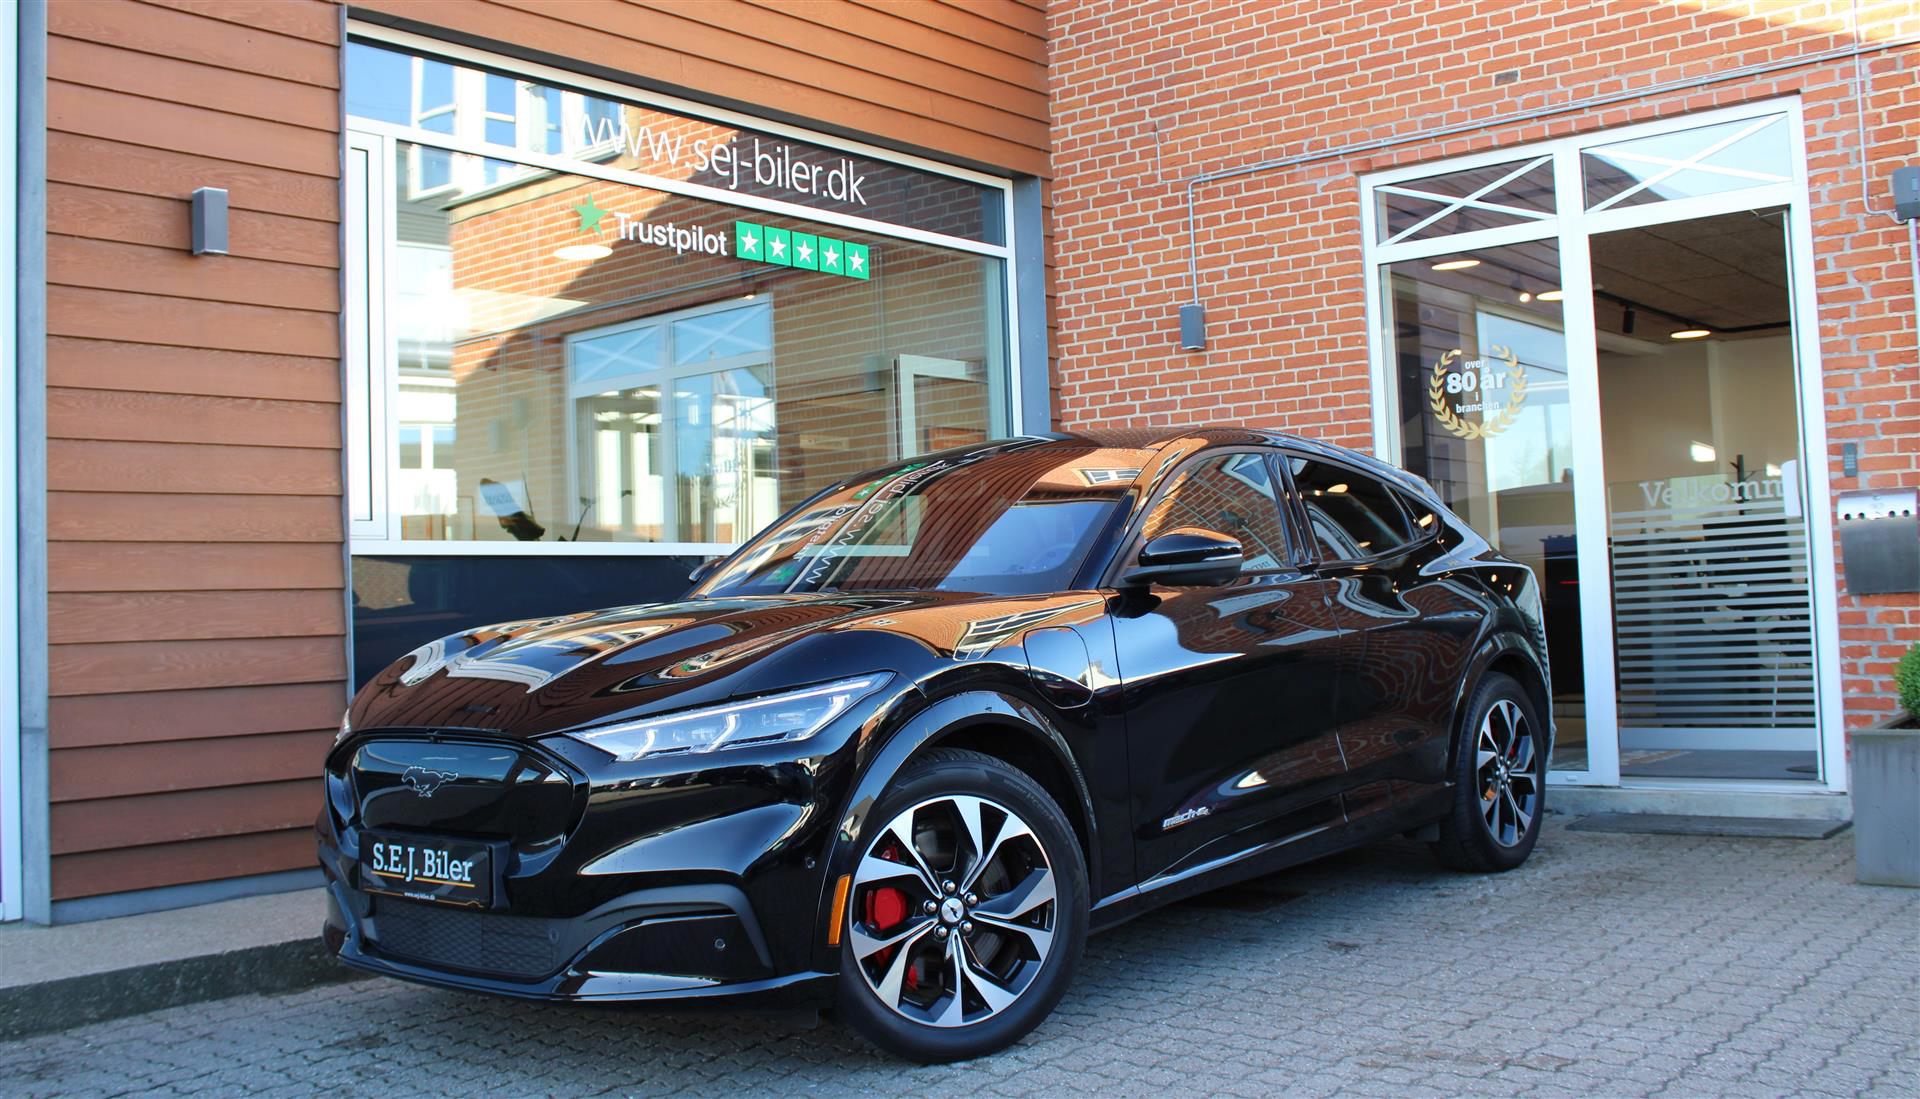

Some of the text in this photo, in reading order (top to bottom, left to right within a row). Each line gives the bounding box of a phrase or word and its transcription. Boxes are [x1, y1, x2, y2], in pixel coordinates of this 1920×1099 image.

[565, 108, 868, 206] www.sej-biler.dk
[613, 212, 728, 256] Trustpilot
[1446, 366, 1507, 394] 80 år
[1464, 359, 1487, 370] over
[1455, 400, 1500, 414] branchen
[372, 842, 473, 883] S.E.J. Biler
